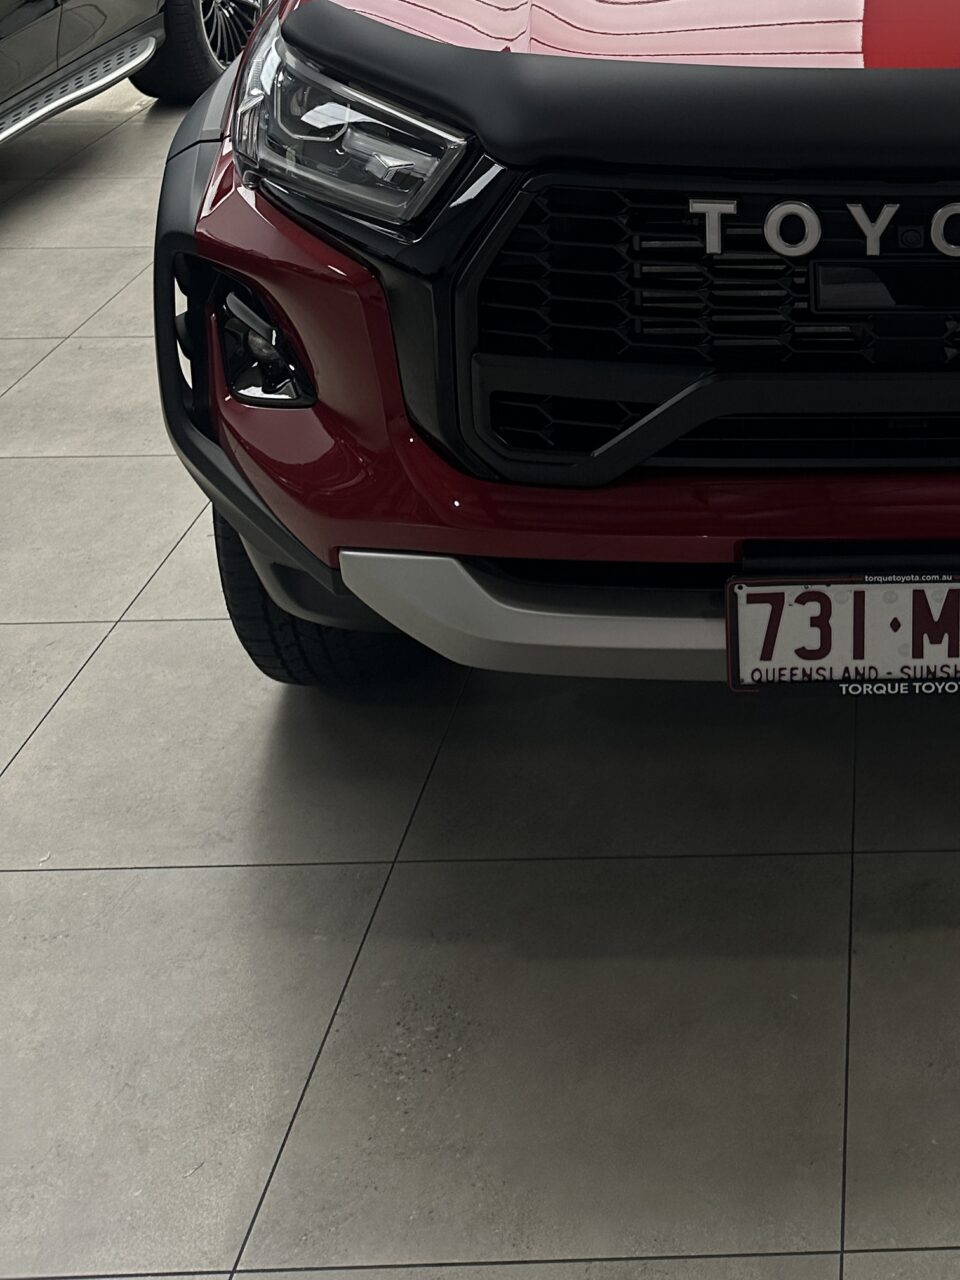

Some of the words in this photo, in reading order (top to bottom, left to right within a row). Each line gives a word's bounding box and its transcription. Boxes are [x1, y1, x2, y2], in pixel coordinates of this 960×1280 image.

[864, 574, 953, 584] torquetoyota.com.au
[751, 666, 878, 683] QUEENSLAND
[839, 682, 909, 696] TORQUE
